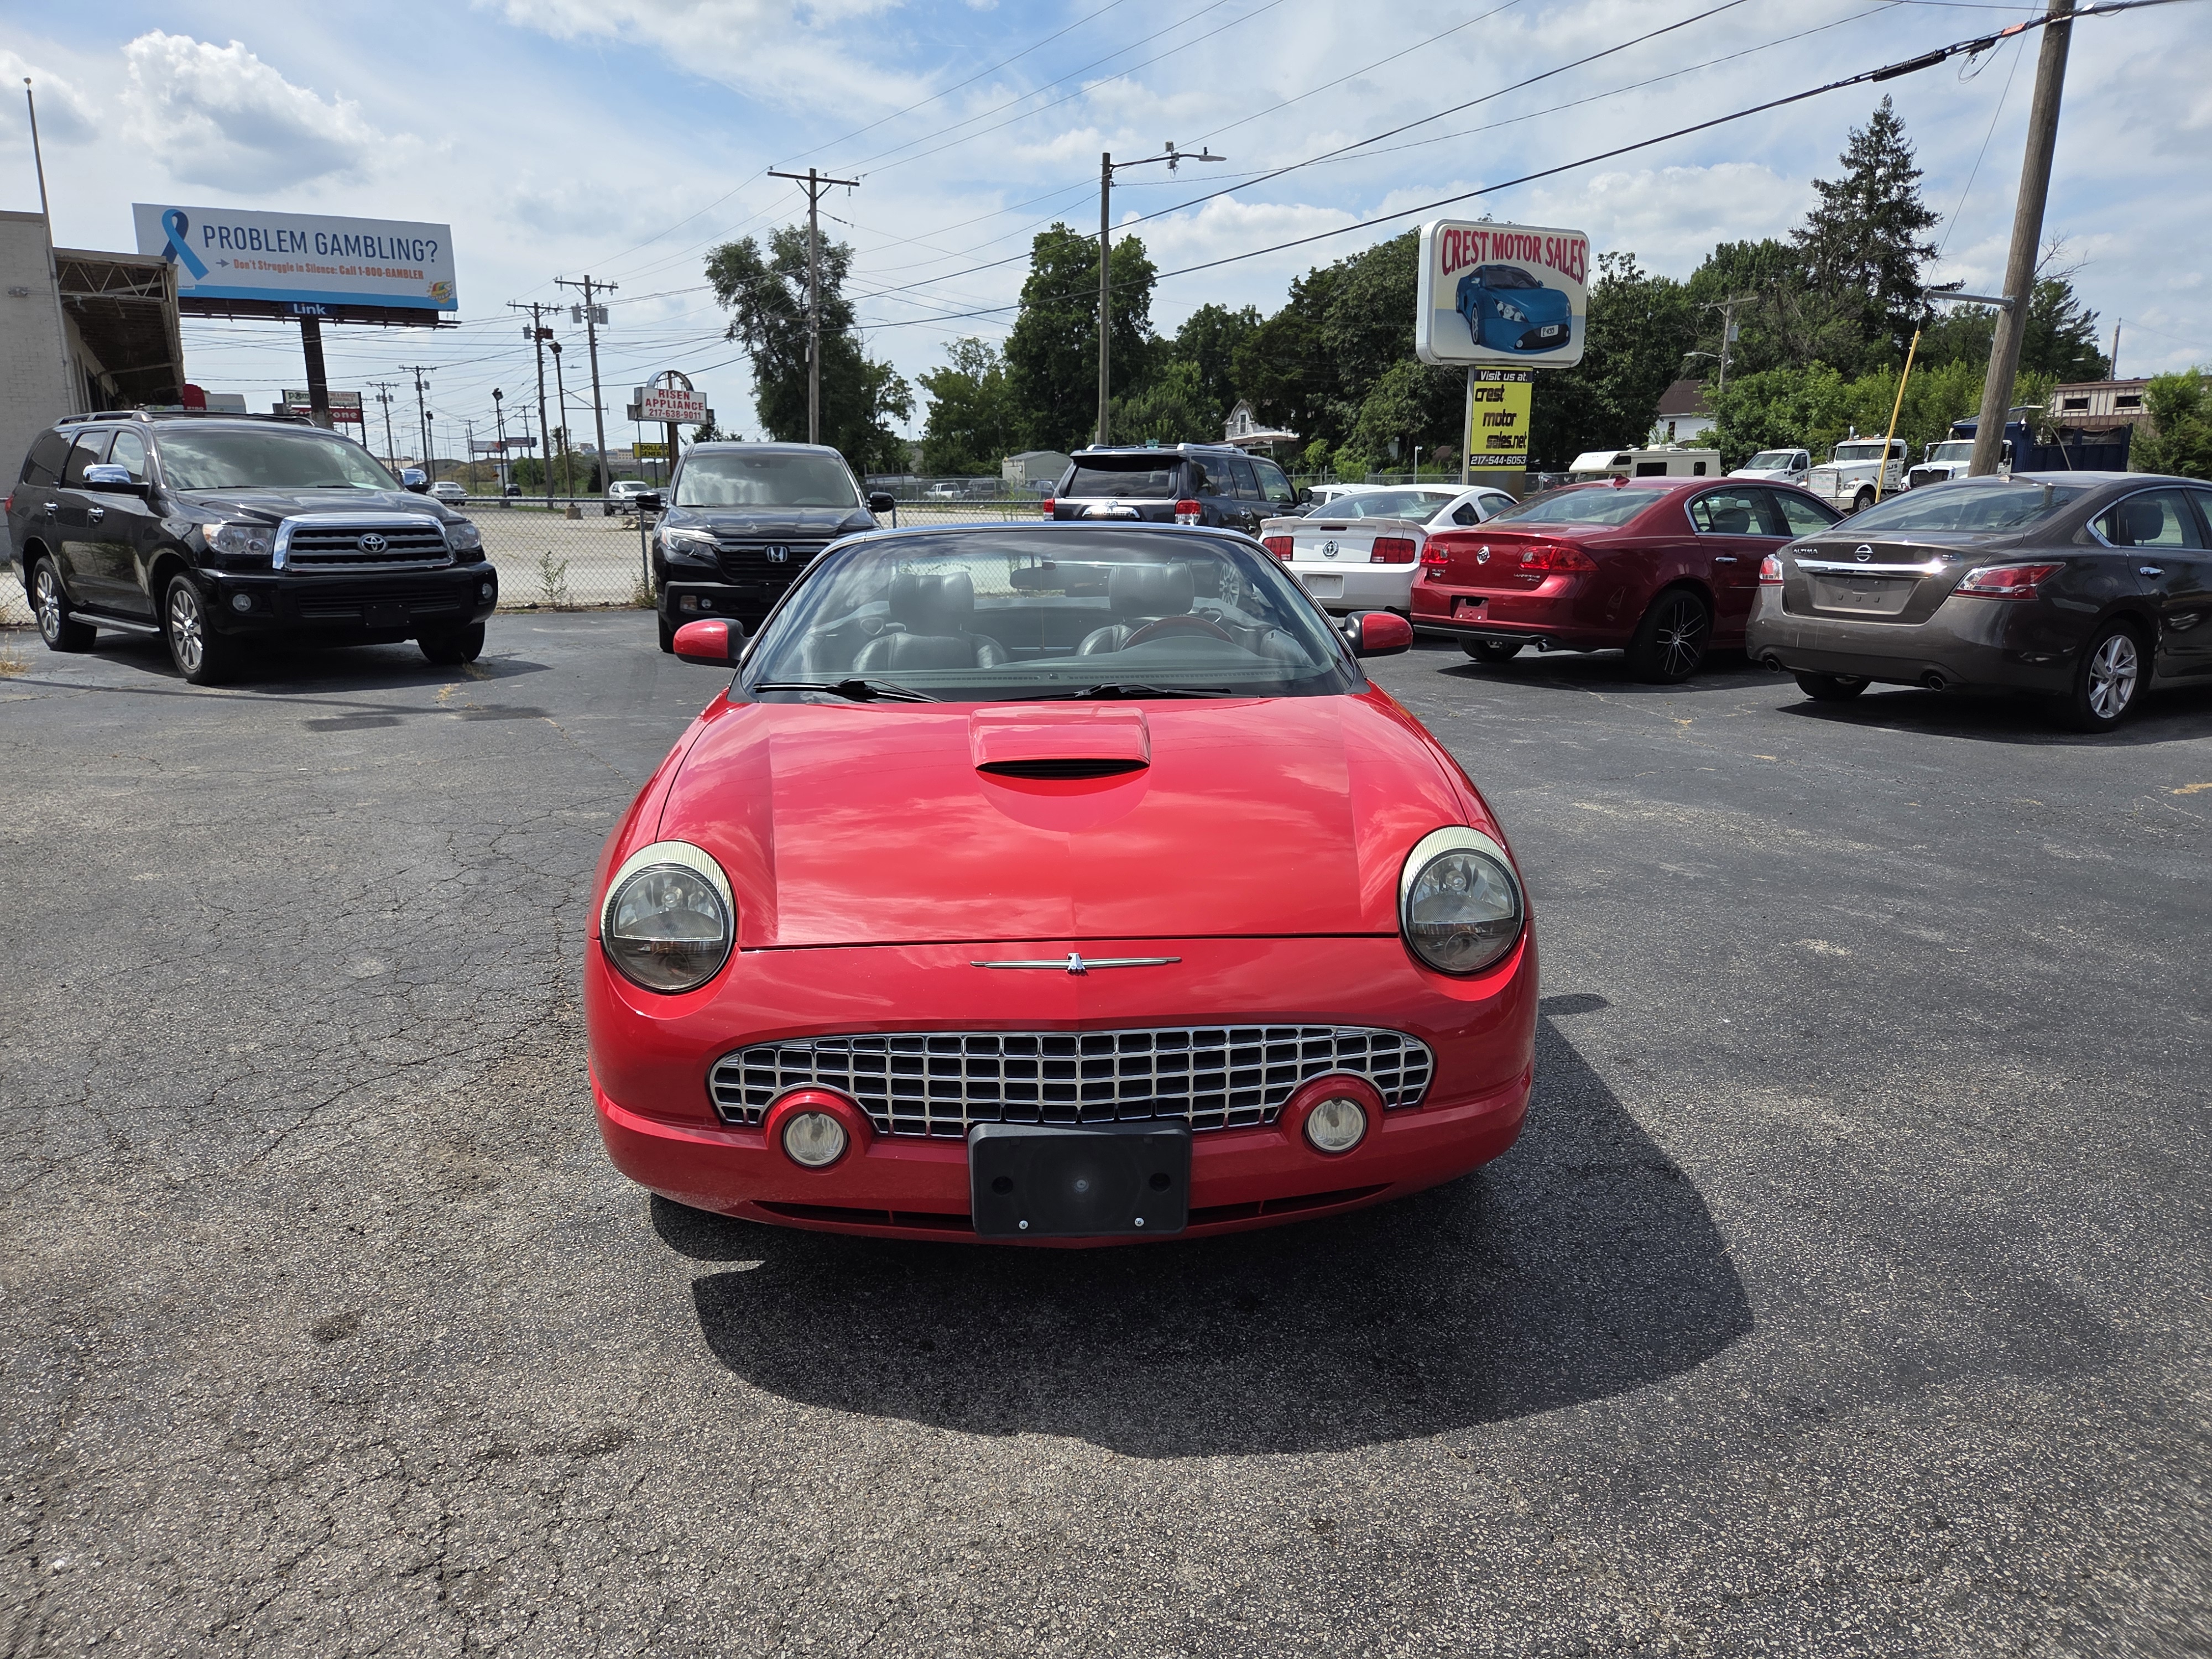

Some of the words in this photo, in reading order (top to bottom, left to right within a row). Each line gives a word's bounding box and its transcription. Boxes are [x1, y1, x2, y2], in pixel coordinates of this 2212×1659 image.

[203, 225, 307, 254] PROBLEM
[315, 232, 438, 263] GAMBLING?
[1442, 228, 1489, 276] CREST
[1491, 232, 1542, 264] MOTOR
[1545, 236, 1586, 286] SALES
[233, 259, 257, 270] Don't
[258, 260, 294, 274] Struggle
[295, 262, 304, 273] in
[305, 262, 338, 274] Silence:
[339, 265, 357, 275] Call
[358, 266, 424, 280] 1-800-GAMBLER
[294, 303, 326, 315] Link
[1480, 370, 1501, 381] Visit
[1503, 372, 1515, 381] us
[659, 389, 690, 400] RISEN
[1474, 384, 1505, 403] crest
[645, 398, 705, 411] APPLIANCE
[649, 408, 701, 420] 217-638-9011
[1482, 408, 1517, 427] motor
[1485, 430, 1527, 450] sales.net
[1470, 455, 1527, 465] 217-544-6053
